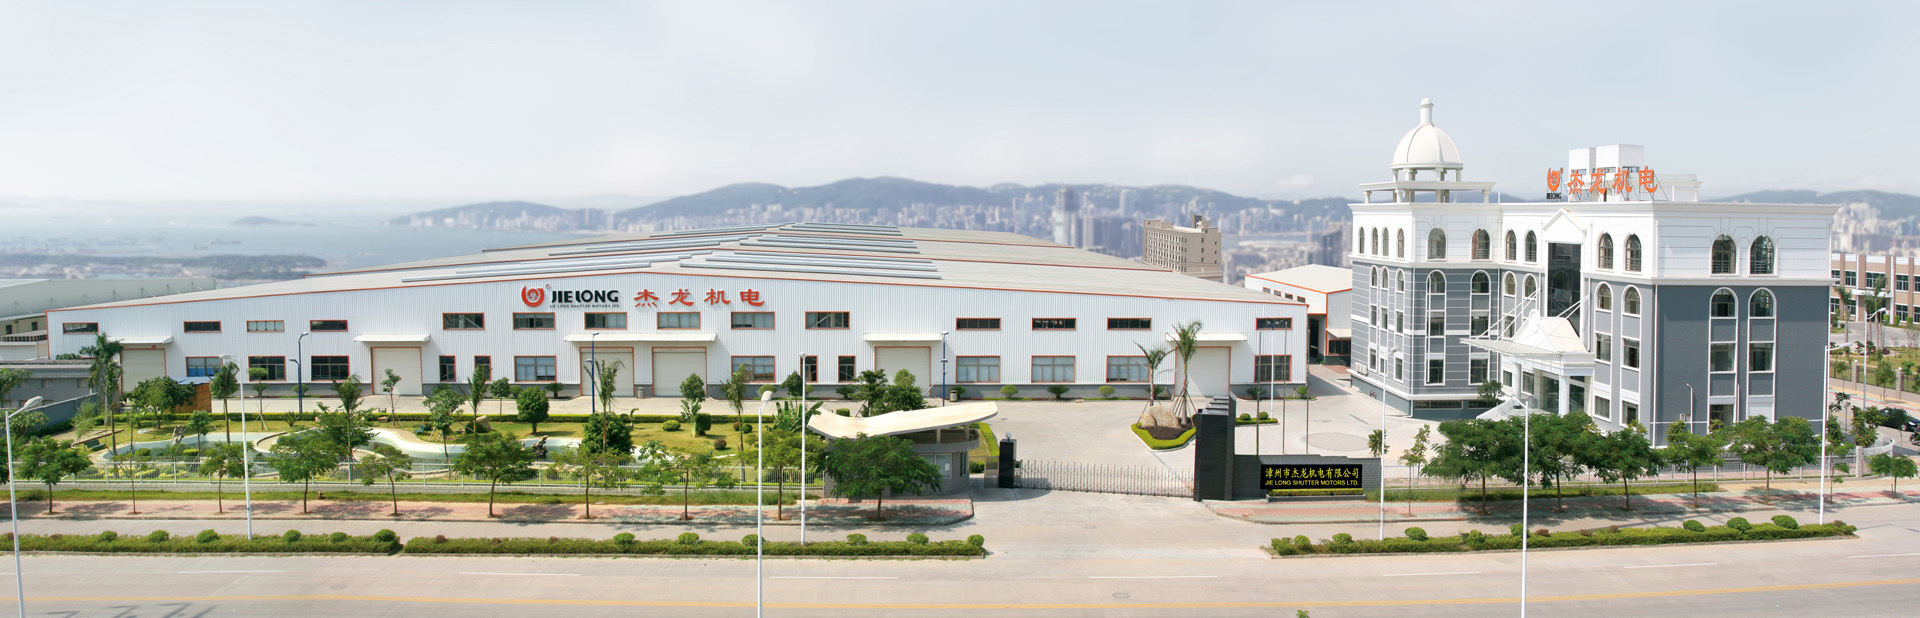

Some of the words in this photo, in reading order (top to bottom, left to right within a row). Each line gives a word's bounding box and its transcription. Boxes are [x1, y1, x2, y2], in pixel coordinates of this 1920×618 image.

[1567, 165, 1658, 195] 杰龙机电
[633, 288, 765, 307] 杰龙机电
[1265, 467, 1359, 479] 漳州市杰龙机电有限公司
